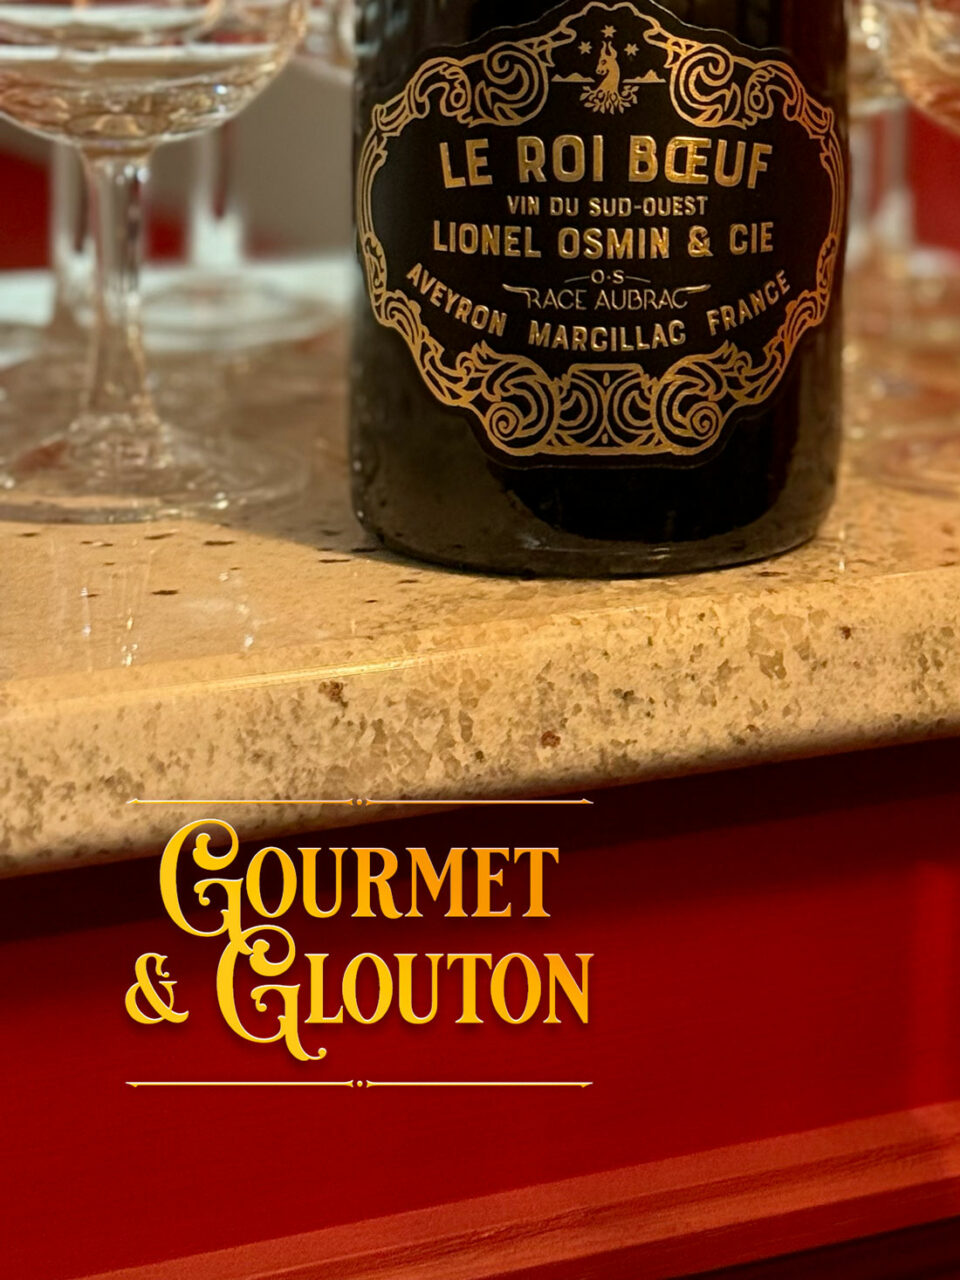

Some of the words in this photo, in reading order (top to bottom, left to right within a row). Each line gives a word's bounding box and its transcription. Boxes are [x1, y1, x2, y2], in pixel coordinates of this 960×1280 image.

[440, 138, 493, 188] LE
[517, 135, 604, 183] ROI
[628, 135, 773, 189] BŒUF
[507, 195, 540, 216] VIN
[550, 196, 579, 217] DU
[589, 195, 709, 217] SUD-OUEST
[433, 220, 542, 258] LIONEL
[558, 226, 670, 260] OSMIN
[687, 225, 713, 257] &
[729, 222, 774, 255] CIE
[405, 262, 507, 337] AVEYRON
[528, 319, 687, 352] MARCILLAC
[705, 269, 791, 336] FRANCE
[525, 288, 588, 311] RACE
[594, 288, 689, 311] AUBRAC
